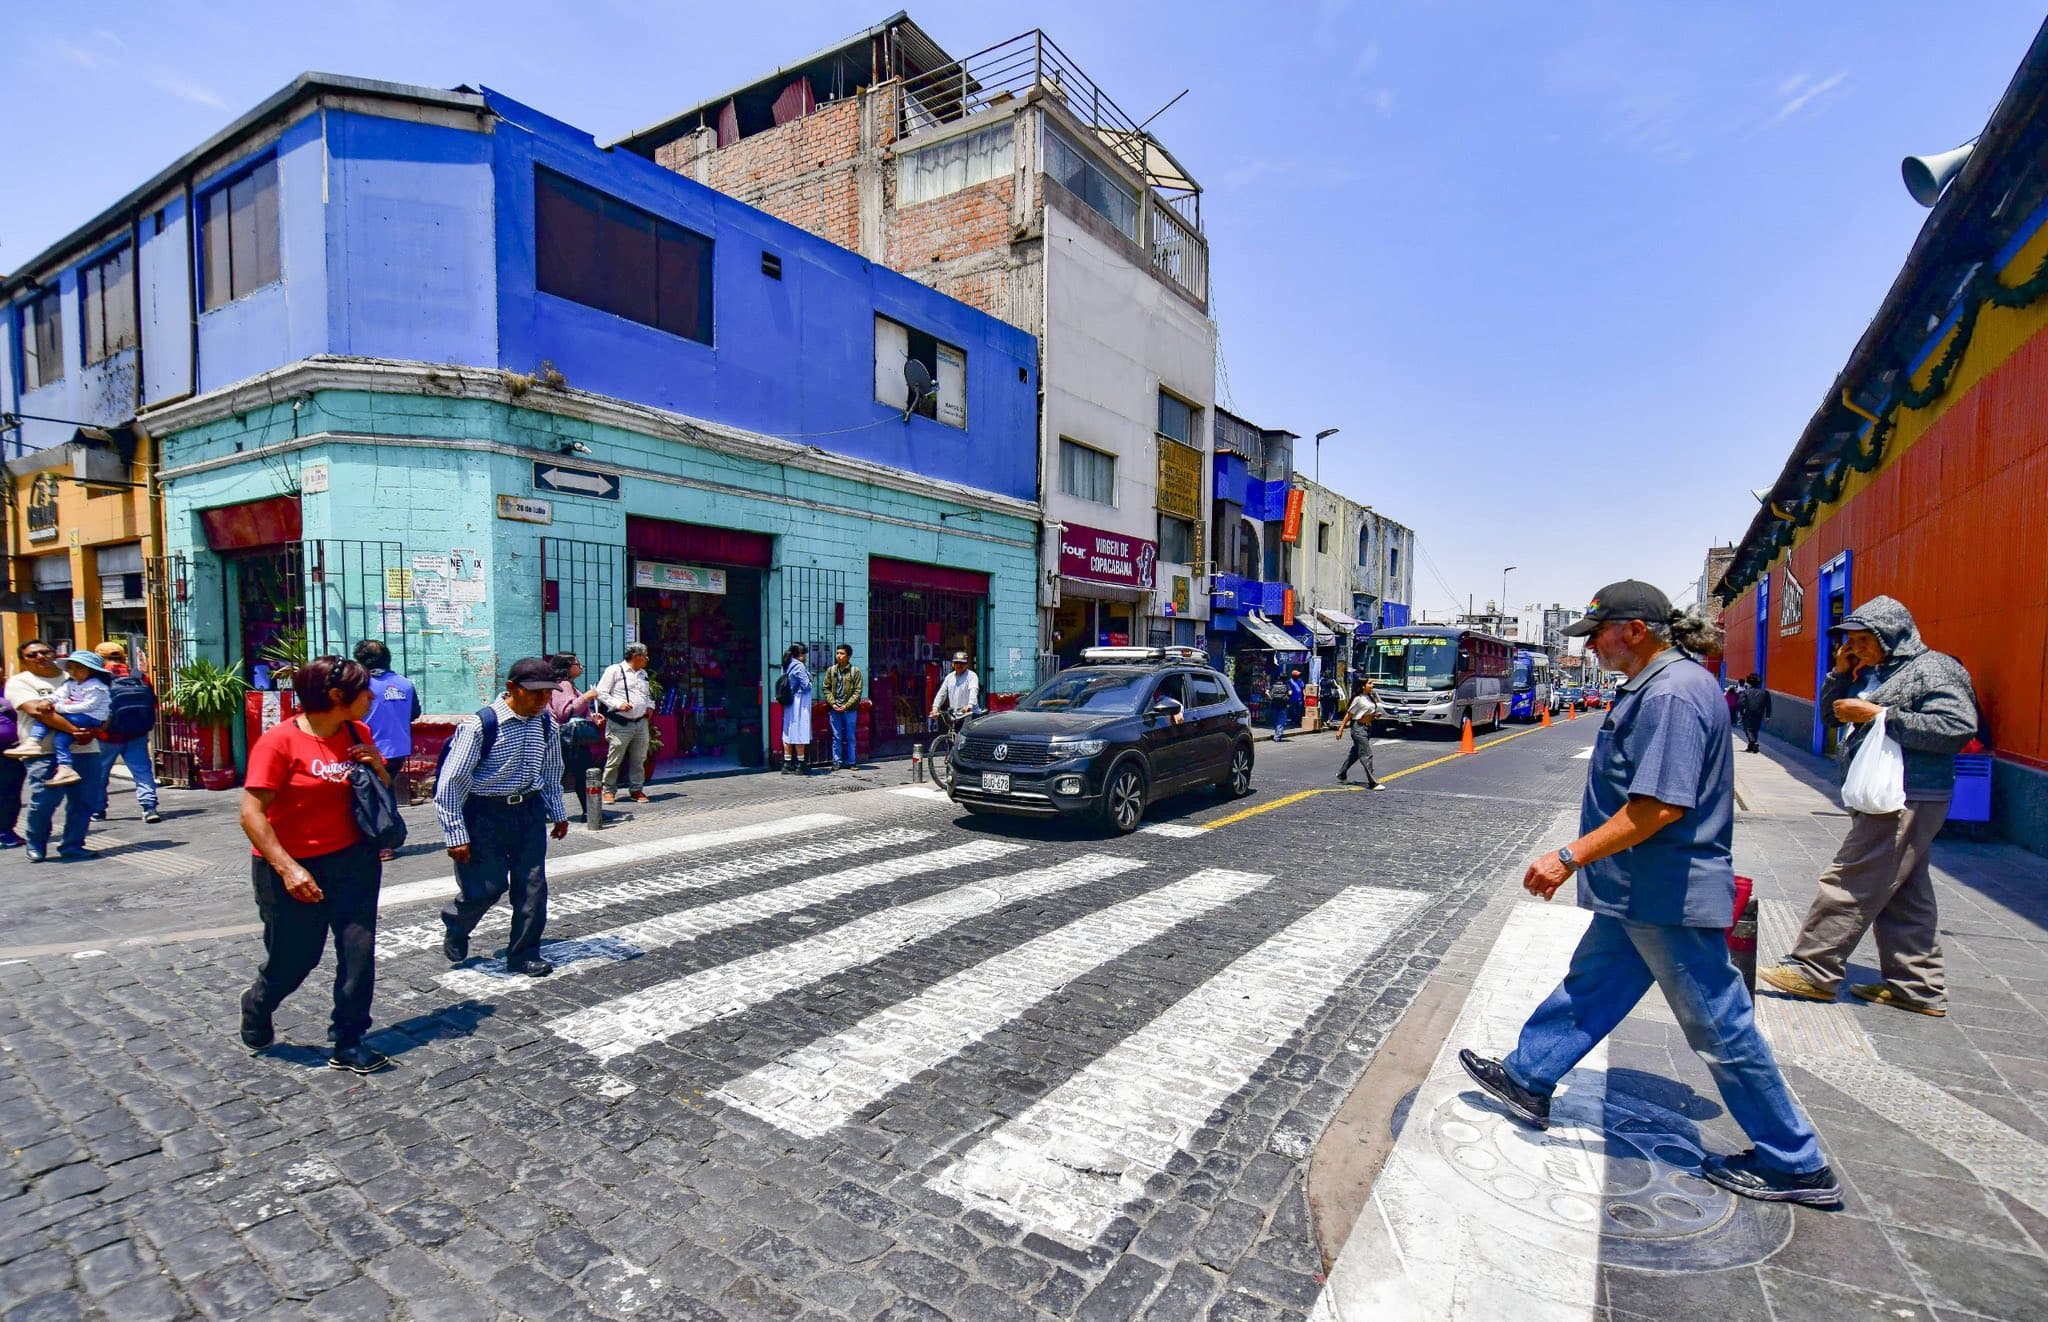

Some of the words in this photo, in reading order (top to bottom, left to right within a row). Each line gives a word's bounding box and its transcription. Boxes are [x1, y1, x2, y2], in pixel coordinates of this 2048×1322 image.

[1096, 537, 1120, 556] VIRGEN
[1120, 542, 1129, 558] DE
[1090, 556, 1133, 577] COPACABANA
